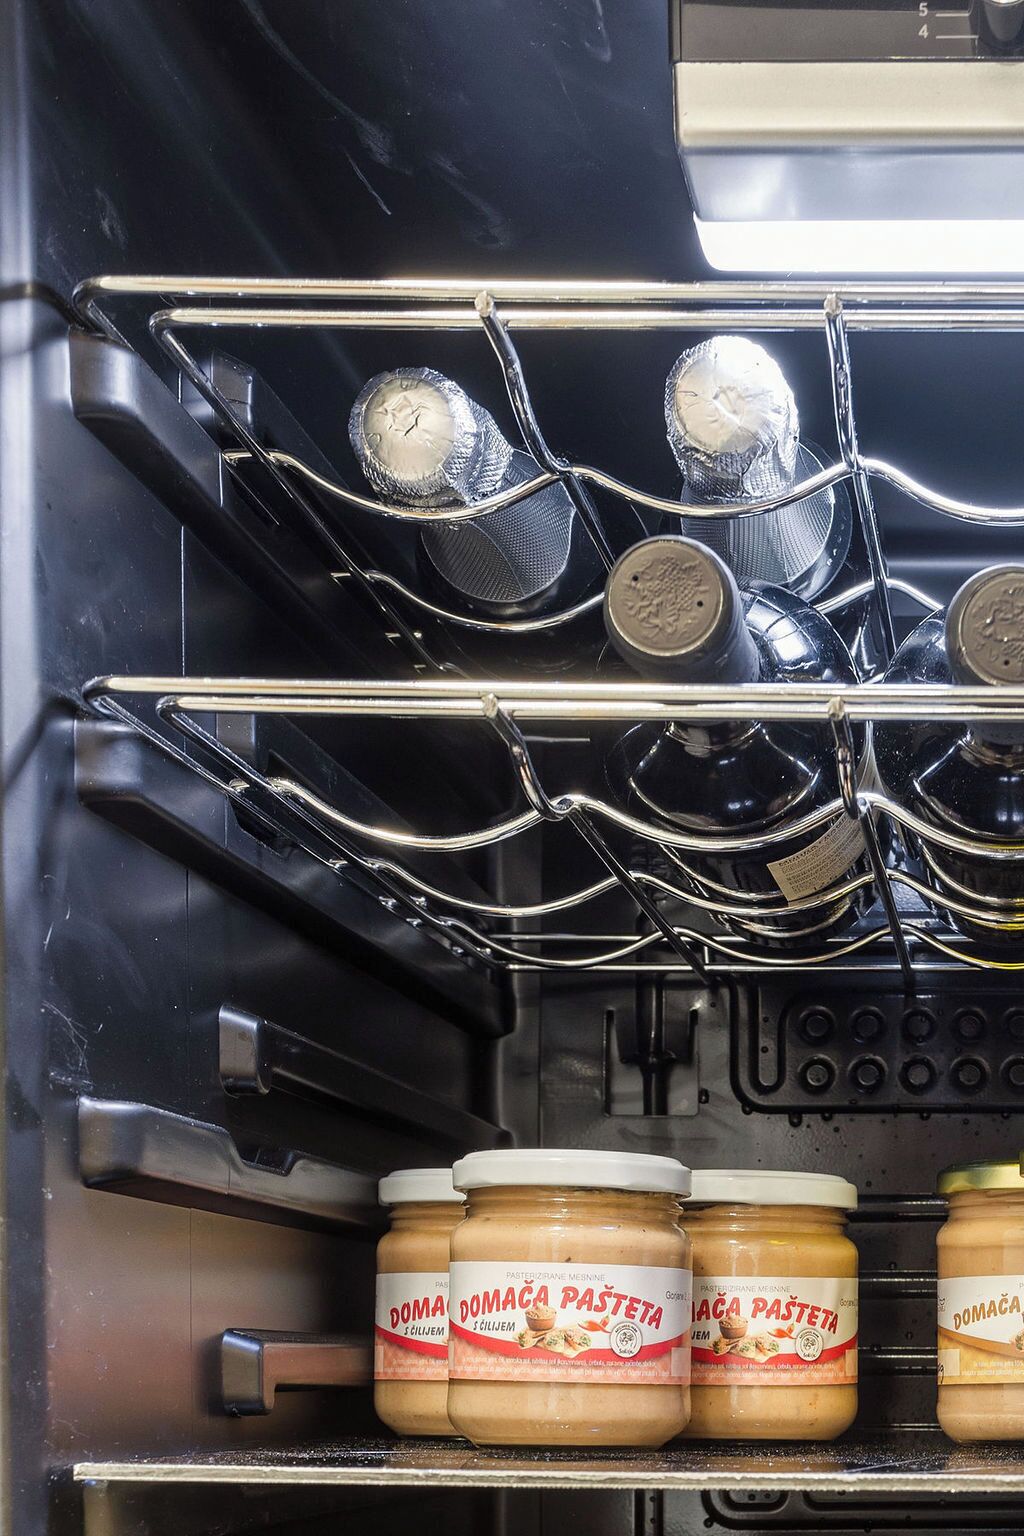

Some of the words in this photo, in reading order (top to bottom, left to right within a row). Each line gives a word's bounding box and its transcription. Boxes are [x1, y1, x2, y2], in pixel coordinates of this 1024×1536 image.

[918, 3, 929, 17] 5
[918, 24, 929, 39] 4
[390, 1295, 449, 1329] DOMA
[459, 1279, 549, 1324] DOMAČA
[559, 1284, 663, 1330] PAŠTETA
[751, 1295, 839, 1334] PAŠTETA
[953, 1293, 1021, 1331] DOMAČA
[403, 1326, 409, 1336] S
[410, 1324, 445, 1336] ČILIJEM
[473, 1321, 478, 1331] S
[480, 1319, 516, 1332] ČILIJEM
